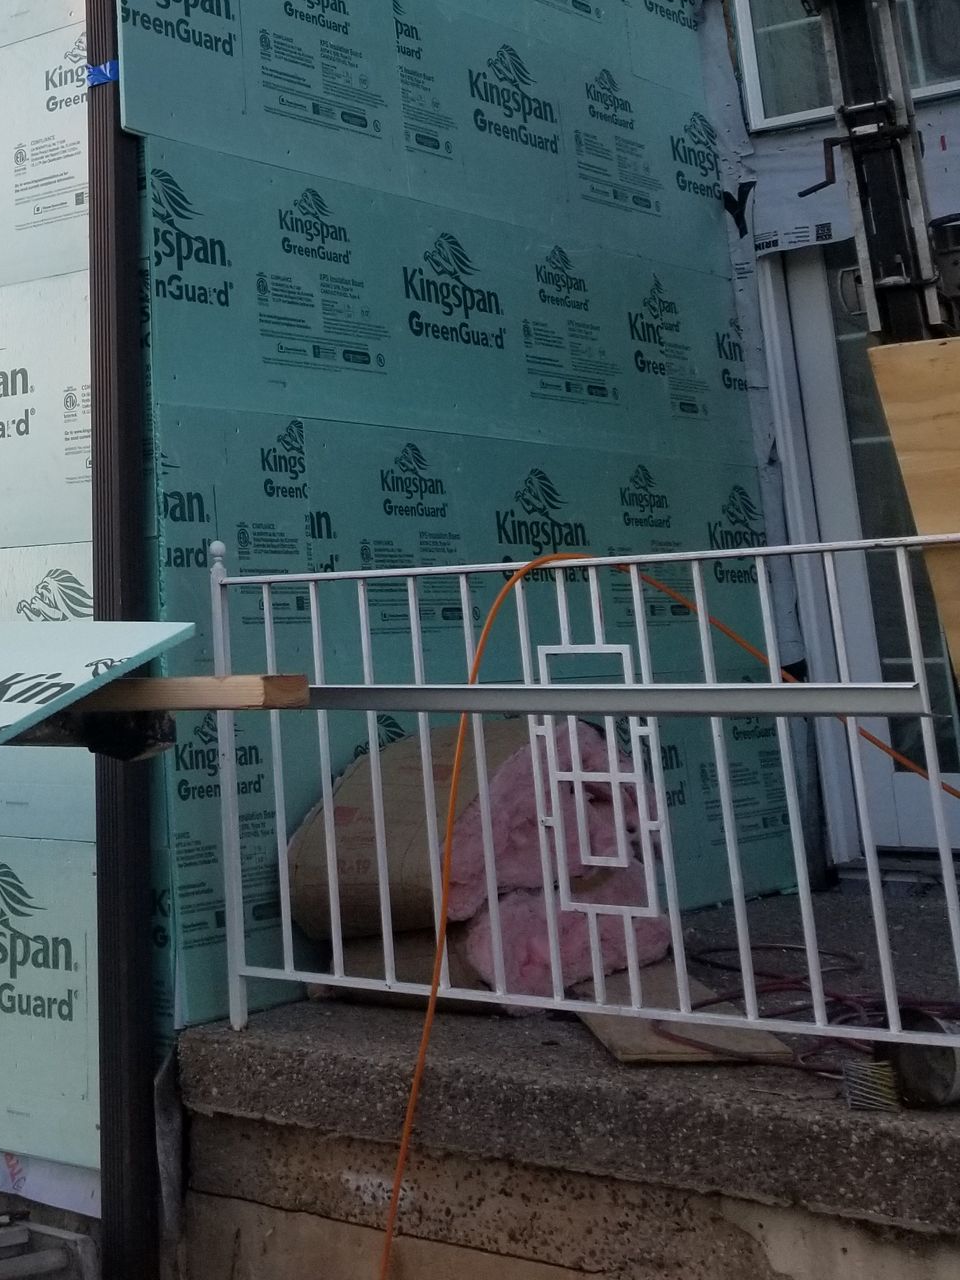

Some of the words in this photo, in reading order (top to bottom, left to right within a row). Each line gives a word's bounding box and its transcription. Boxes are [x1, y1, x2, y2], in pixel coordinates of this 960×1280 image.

[283, 0, 349, 35] GreenGuard
[468, 69, 554, 123] Kingspan
[473, 108, 559, 154] GreenGuard
[279, 209, 348, 244] Kingspan
[281, 236, 350, 265] GreenGuard
[402, 266, 501, 319] Kingspan
[381, 470, 444, 500] Kingspan
[383, 498, 446, 518] GreenGuard
[496, 511, 586, 556] Kingspan
